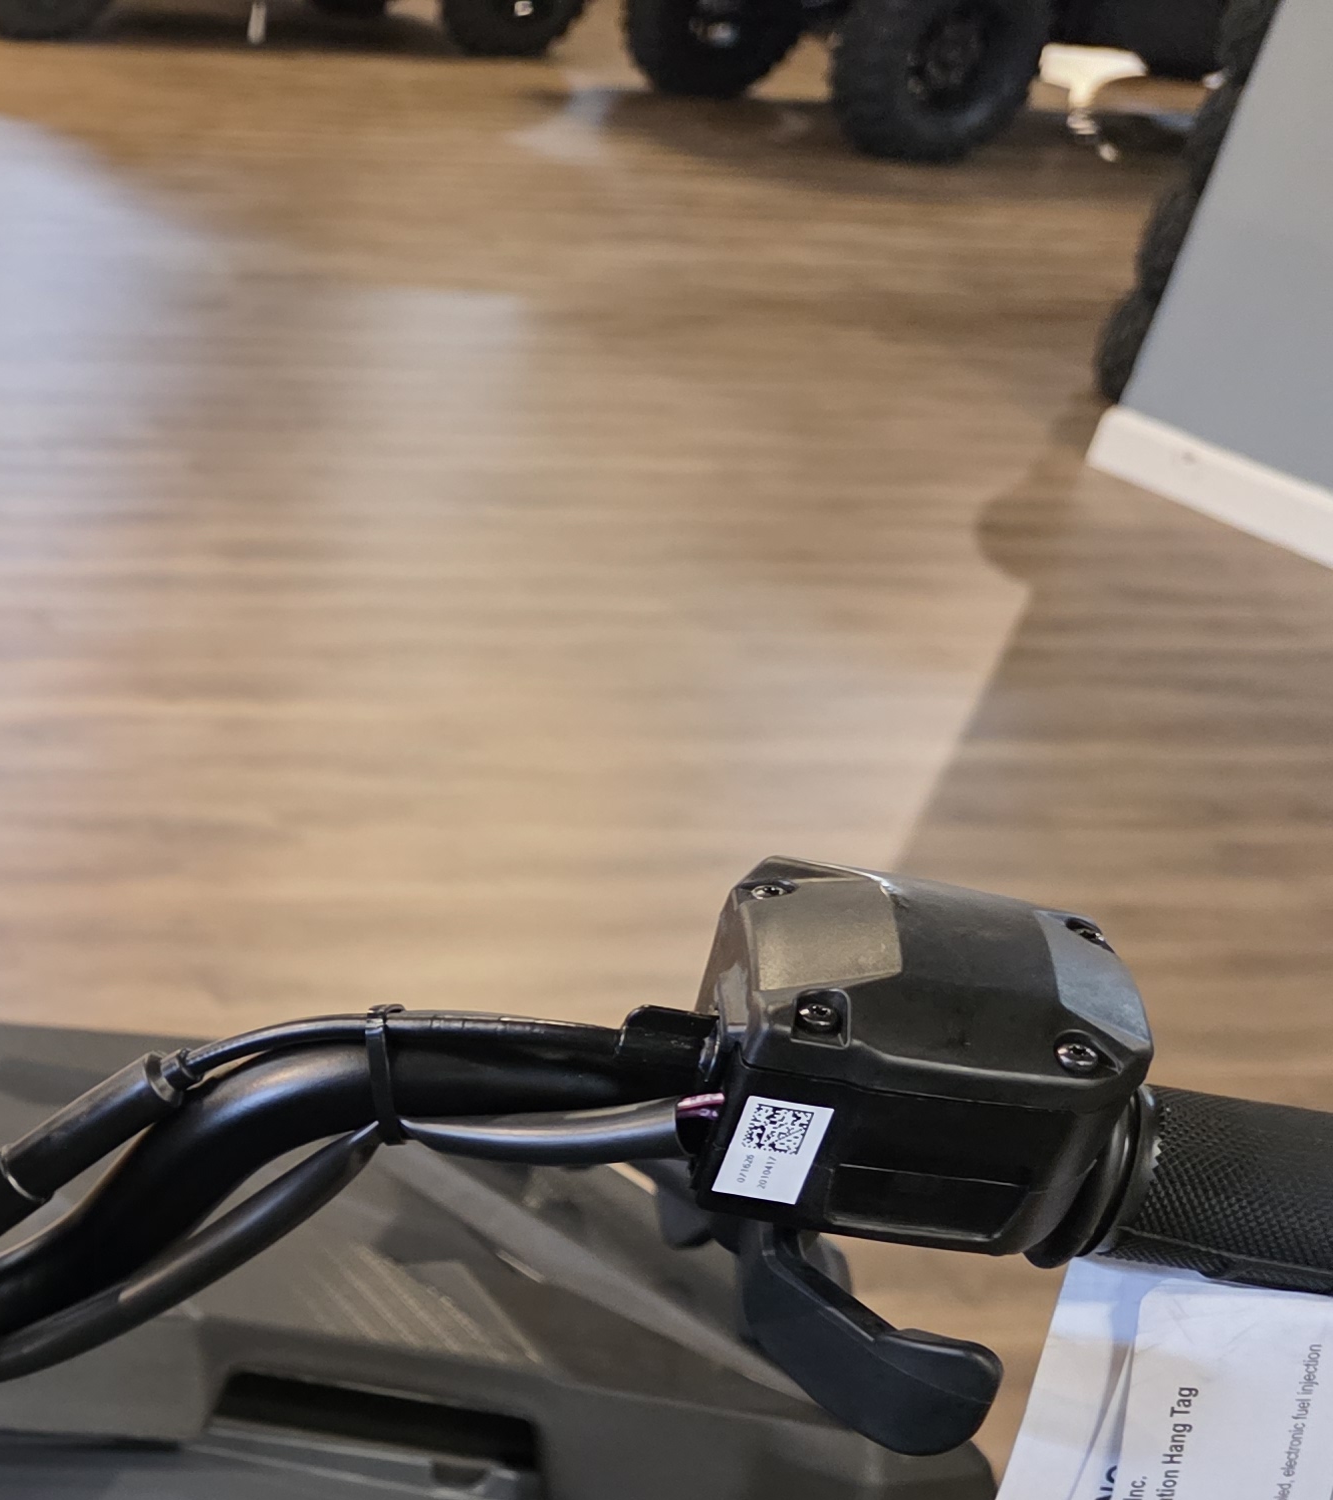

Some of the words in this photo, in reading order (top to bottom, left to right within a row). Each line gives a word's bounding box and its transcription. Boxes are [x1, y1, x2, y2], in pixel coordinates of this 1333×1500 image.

[1297, 1343, 1322, 1395] injection
[1170, 1386, 1199, 1418] Tag
[1291, 1398, 1311, 1420] fuel
[1161, 1422, 1193, 1465] Hang
